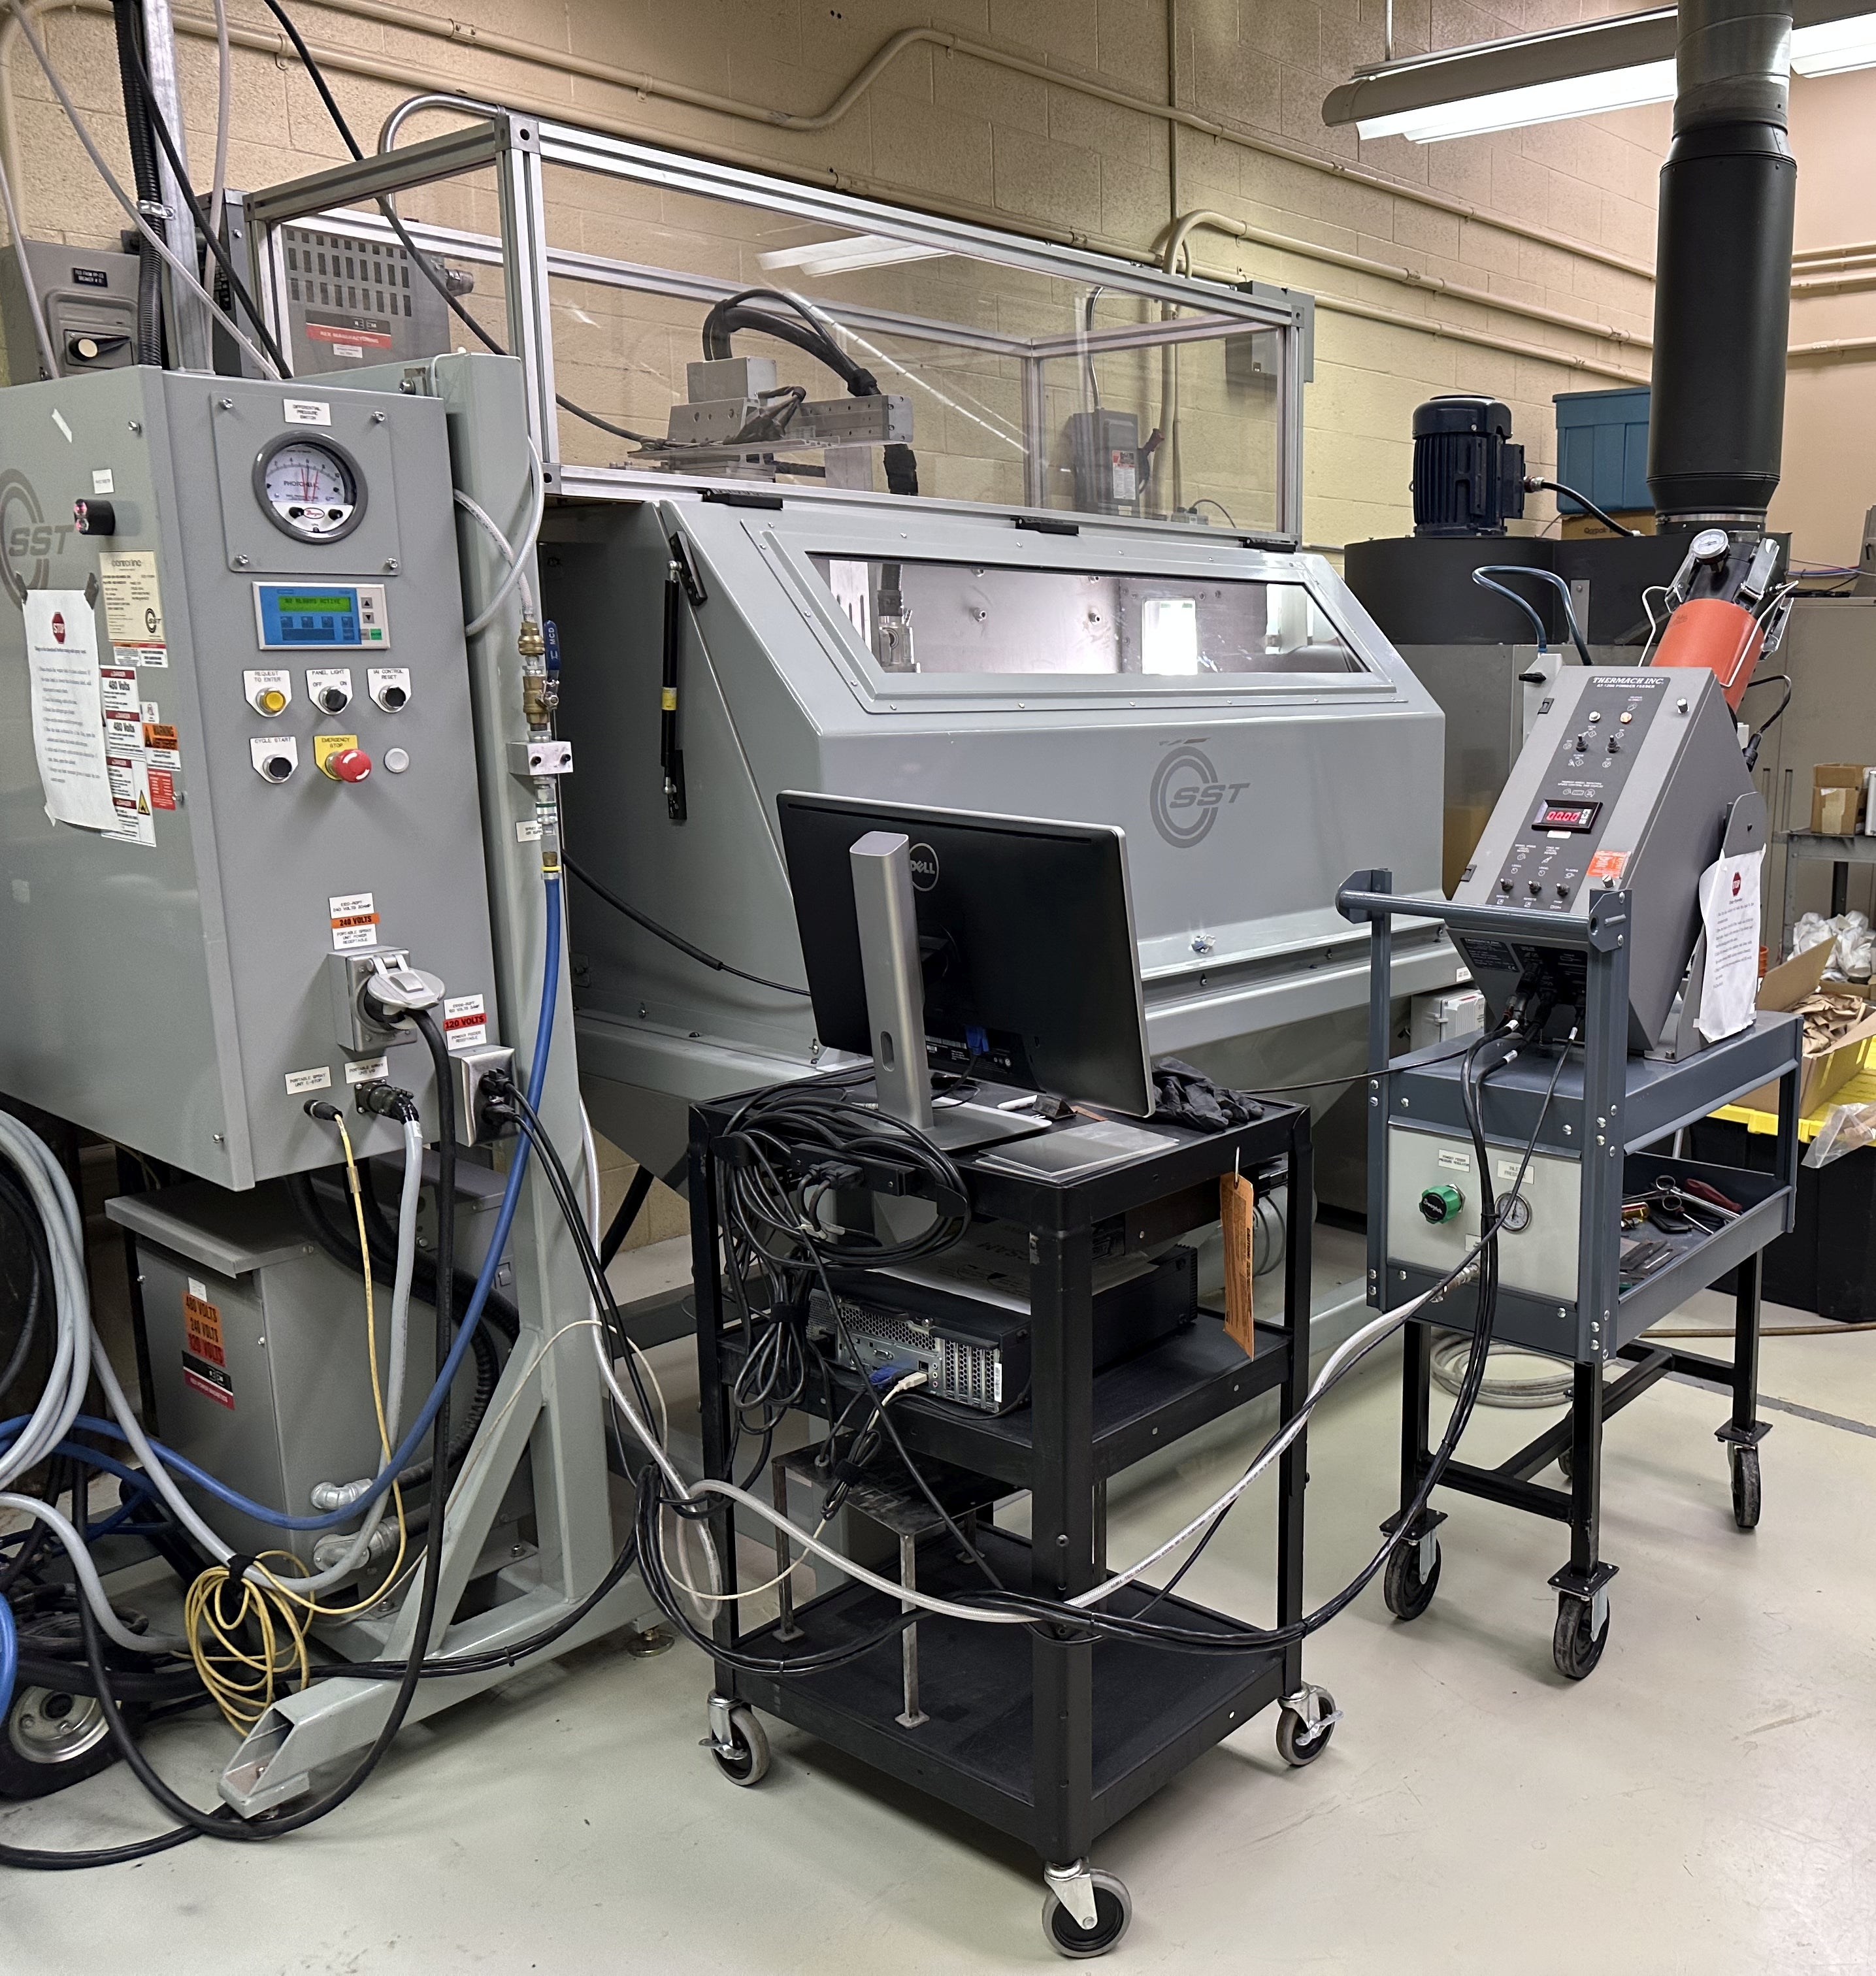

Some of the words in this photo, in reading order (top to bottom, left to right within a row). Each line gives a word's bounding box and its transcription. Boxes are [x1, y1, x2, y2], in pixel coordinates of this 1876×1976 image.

[8, 524, 74, 557] SST
[1170, 782, 1251, 809] SST
[910, 859, 936, 874] DELL
[339, 918, 352, 927] 240
[352, 915, 372, 925] VOLTS
[445, 1020, 459, 1029] 120
[461, 1015, 484, 1025] VOLTS
[197, 1300, 218, 1323] VOLTS
[202, 1321, 219, 1343] VOLTS
[204, 1340, 223, 1364] VOLTS
